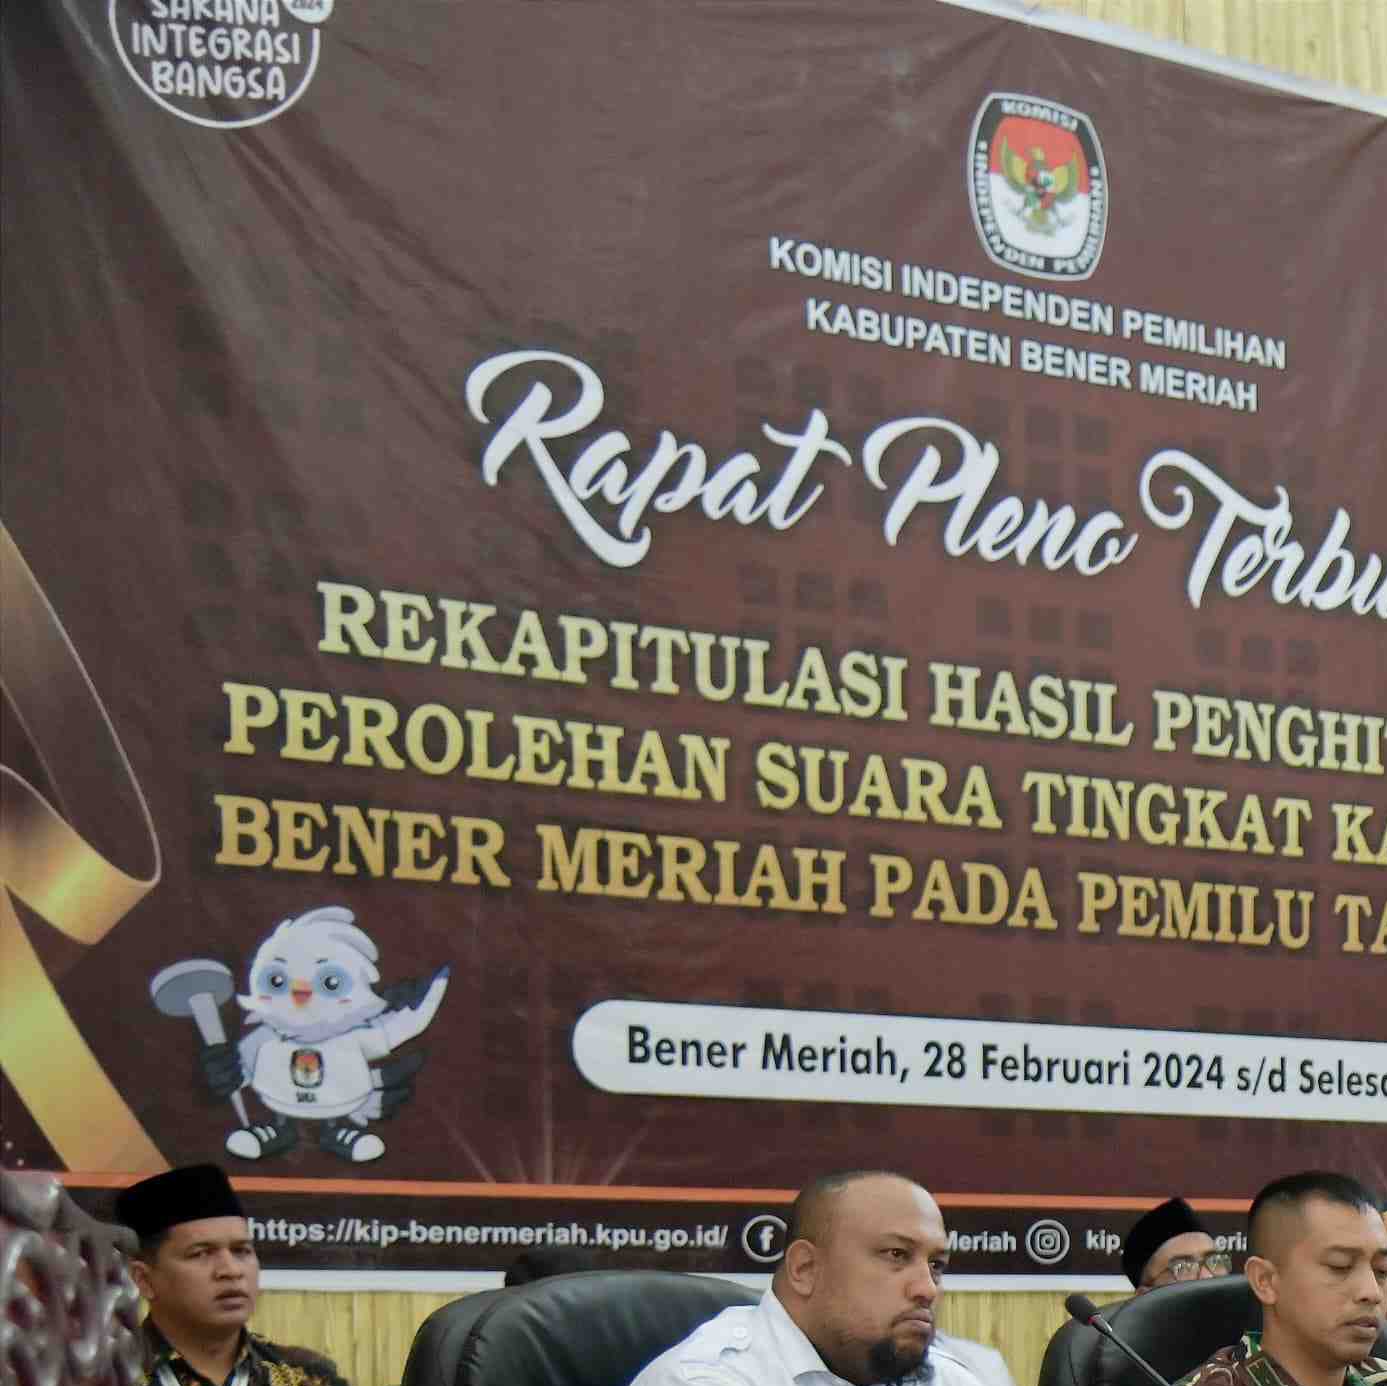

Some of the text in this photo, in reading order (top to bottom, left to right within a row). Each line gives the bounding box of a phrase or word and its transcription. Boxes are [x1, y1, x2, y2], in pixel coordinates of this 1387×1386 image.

[131, 21, 301, 65] INTEGRASI
[151, 60, 286, 101] BANGSA
[770, 236, 1287, 371] KOMISI INDEPENDEN PEMILIHAN
[806, 297, 1259, 413] KABUPATEN BENER MERIAH
[465, 348, 852, 568] Rapat
[862, 415, 1138, 578] Pleno
[316, 581, 909, 722] REKAPITULASI
[928, 660, 1133, 748] HASIL
[221, 681, 730, 803] PEROLEHAN
[755, 742, 1002, 831] SUARA
[1021, 770, 1312, 858] TINGKAT
[213, 793, 512, 890] BENER
[535, 823, 848, 916] MERIAH
[868, 852, 1058, 932] PADA
[1076, 870, 1314, 950] PEMILU
[626, 1024, 747, 1070] Bener
[760, 1032, 910, 1086] Meriah,
[922, 1040, 966, 1080] 28
[980, 1042, 1131, 1088] Februari
[1142, 1050, 1225, 1091] 2024
[1235, 1053, 1288, 1096] s/d
[247, 1216, 729, 1250] https://kip-benermeriah.kpu.go.id/
